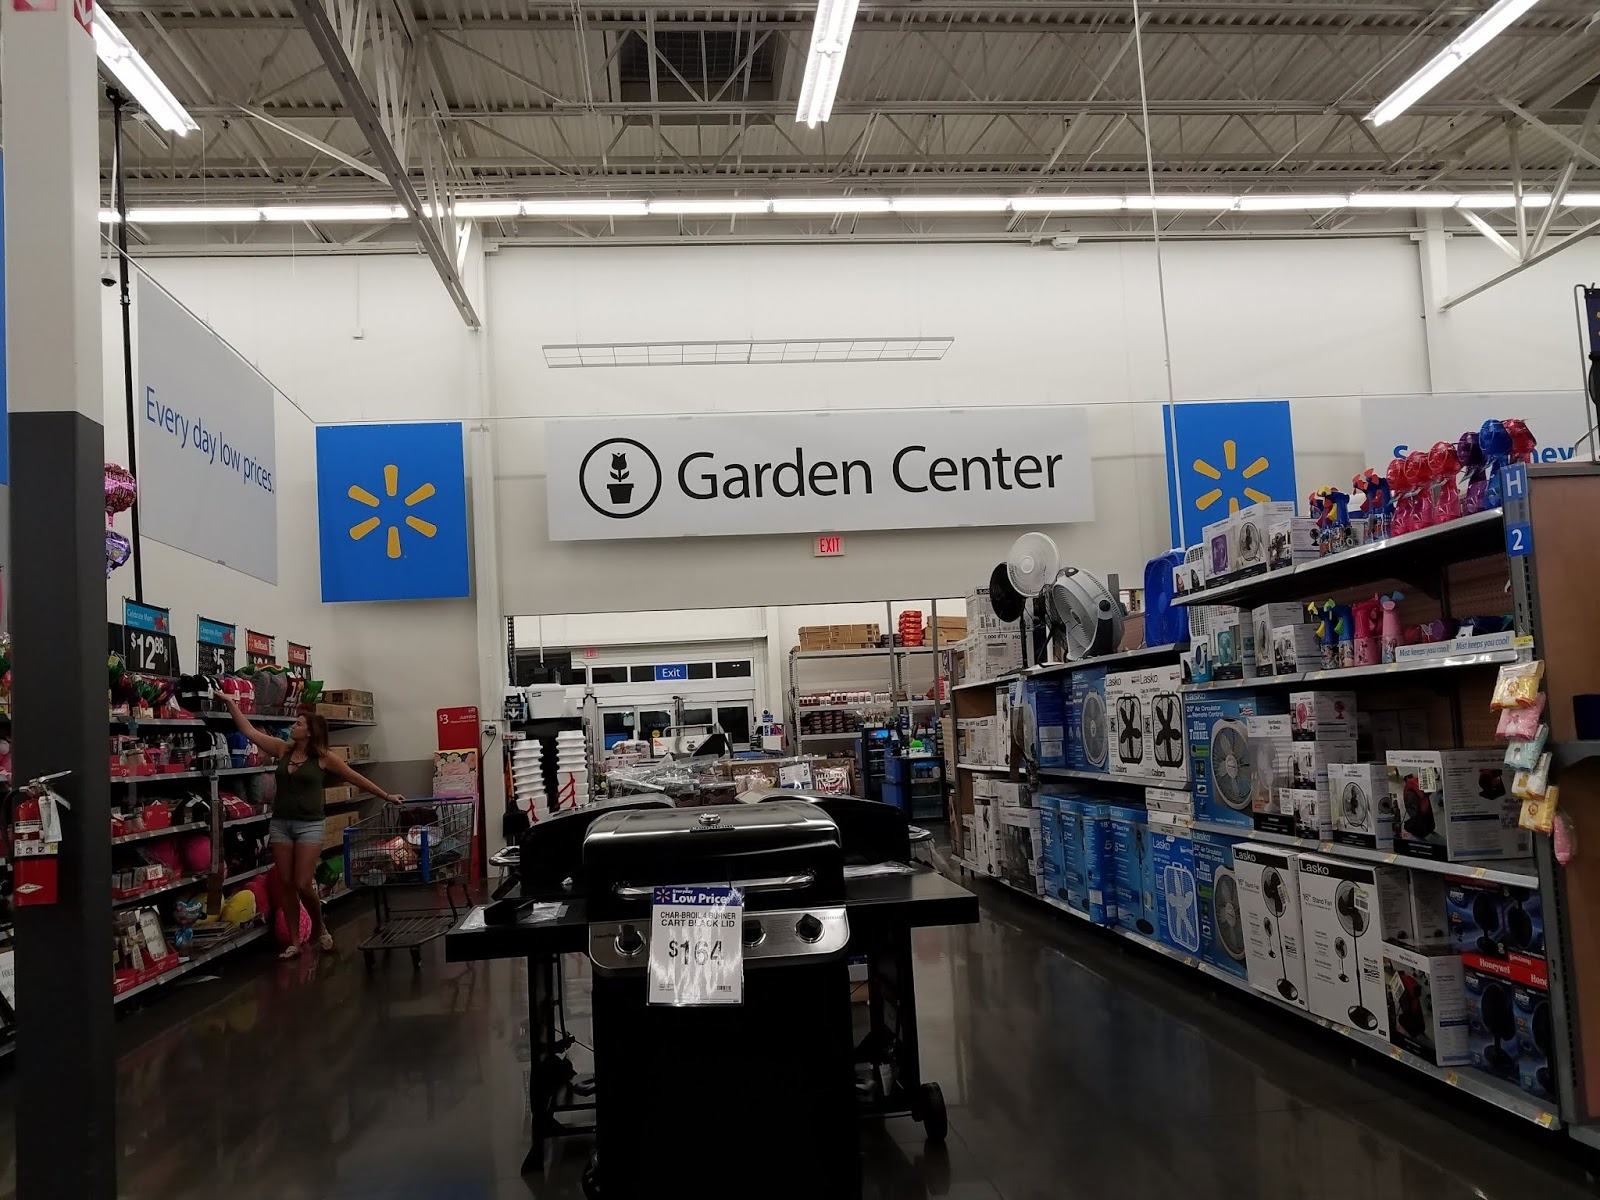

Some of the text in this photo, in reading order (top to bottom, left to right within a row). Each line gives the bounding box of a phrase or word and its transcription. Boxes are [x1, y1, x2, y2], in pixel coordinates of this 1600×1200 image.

[146, 385, 275, 494] Every day low prices.
[677, 445, 1063, 500] Garden Center
[1505, 469, 1523, 497] H
[819, 538, 841, 554] EXIT
[1511, 528, 1524, 551] 2
[1456, 642, 1467, 650] Mist
[1467, 640, 1484, 650] keeps
[1483, 640, 1495, 649] you
[213, 648, 225, 675] $5
[662, 668, 681, 678] Exit
[1140, 673, 1158, 685] Lasko
[1106, 676, 1122, 687] Lasko
[1185, 692, 1206, 701] Lasko
[438, 713, 449, 725] $3
[1192, 830, 1211, 842] Lasko
[1152, 837, 1171, 851] Lasko
[1234, 849, 1257, 863] Lasko
[1300, 859, 1330, 876] Lasko
[672, 893, 696, 903] Low
[1312, 895, 1324, 906] Stand
[1324, 898, 1333, 907] Fan
[661, 919, 735, 928] CART BLACK LID
[668, 939, 724, 966] $164
